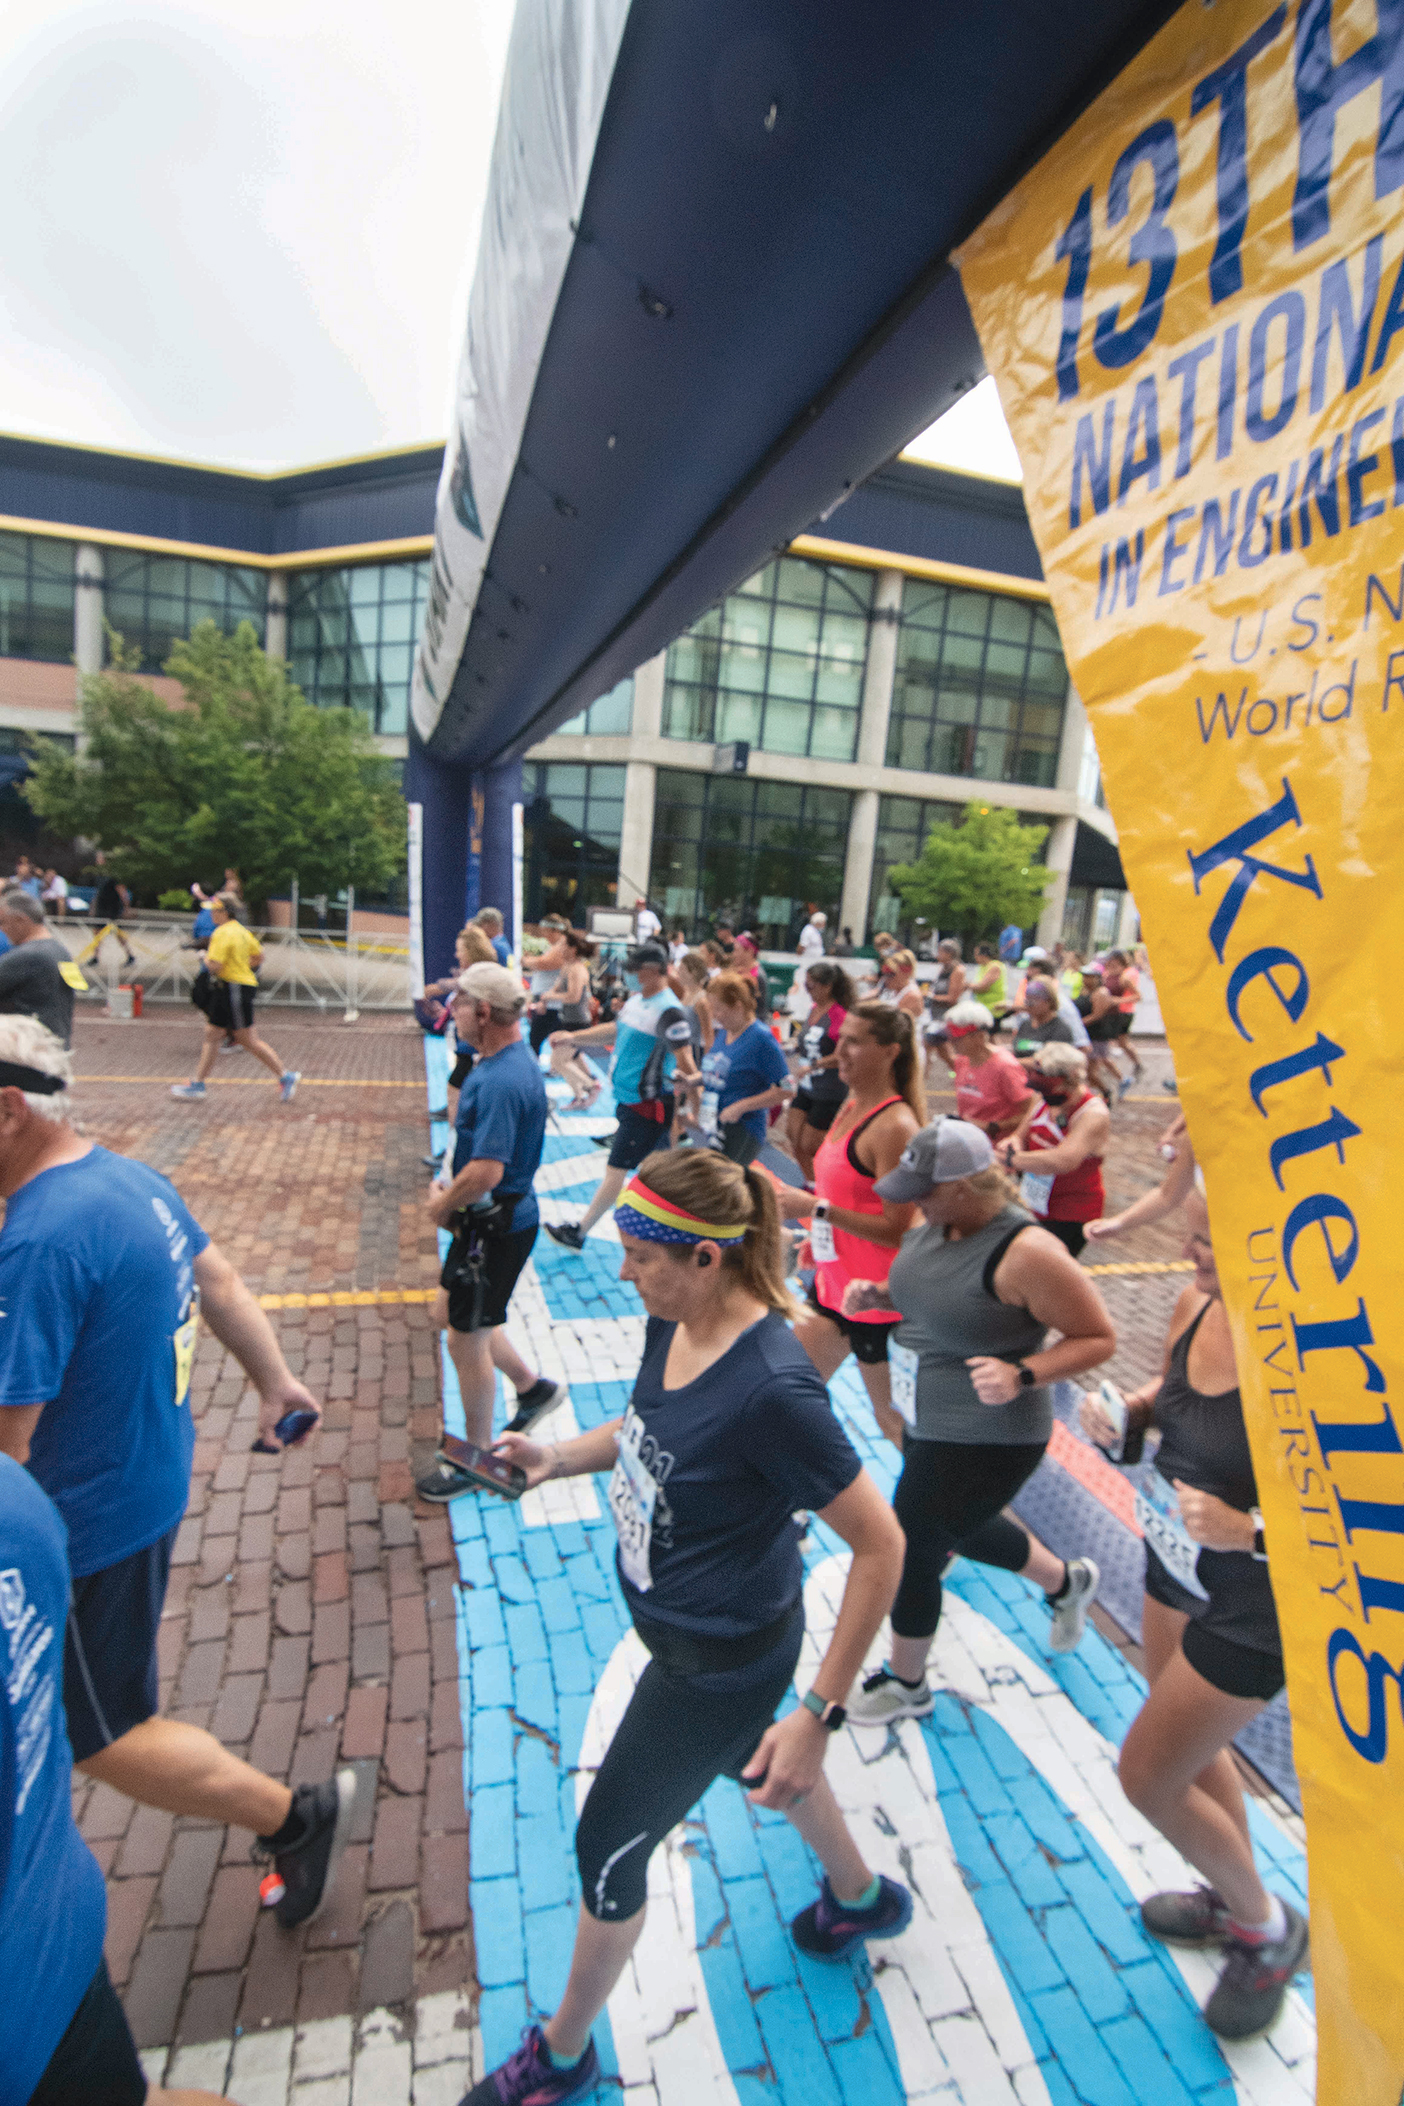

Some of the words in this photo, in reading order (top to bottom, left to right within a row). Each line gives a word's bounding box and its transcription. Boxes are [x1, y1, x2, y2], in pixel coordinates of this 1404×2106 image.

[1053, 0, 1404, 404] 13TH
[1094, 526, 1145, 621] IN
[1229, 592, 1335, 664] U.S.
[1196, 658, 1358, 744] World
[1247, 1226, 1355, 1617] UNIVERSITY
